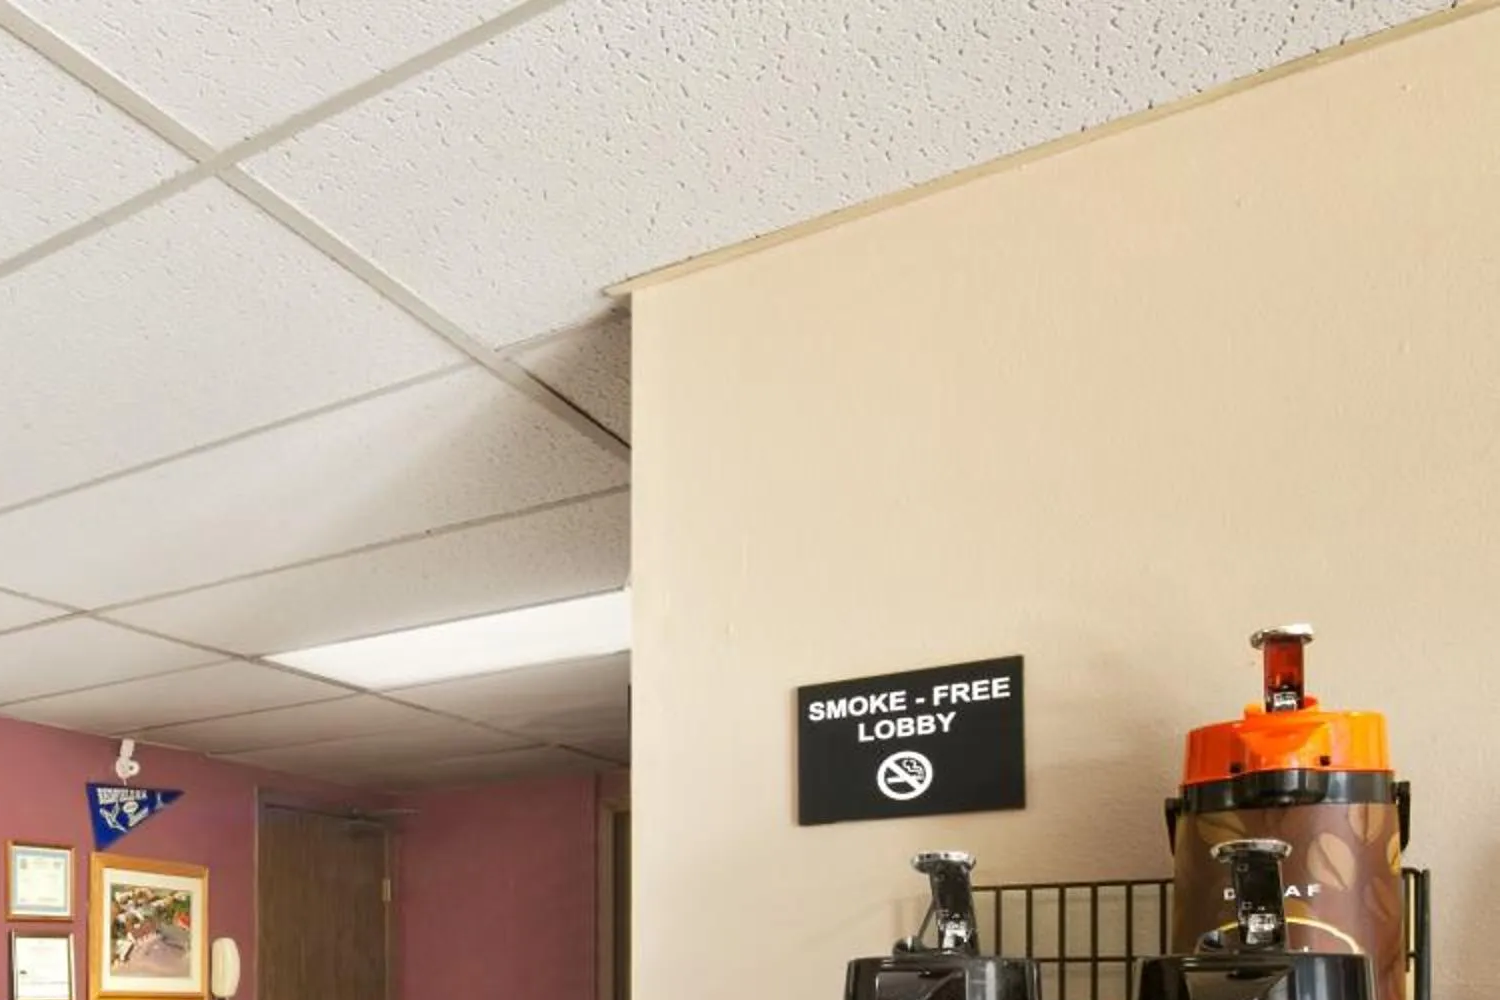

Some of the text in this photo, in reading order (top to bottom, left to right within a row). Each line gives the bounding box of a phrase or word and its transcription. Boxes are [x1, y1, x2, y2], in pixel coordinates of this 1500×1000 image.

[808, 690, 907, 722] SMOKE
[933, 676, 1011, 706] FREE
[857, 711, 957, 743] LOBBY
[1223, 883, 1322, 901] DAF
